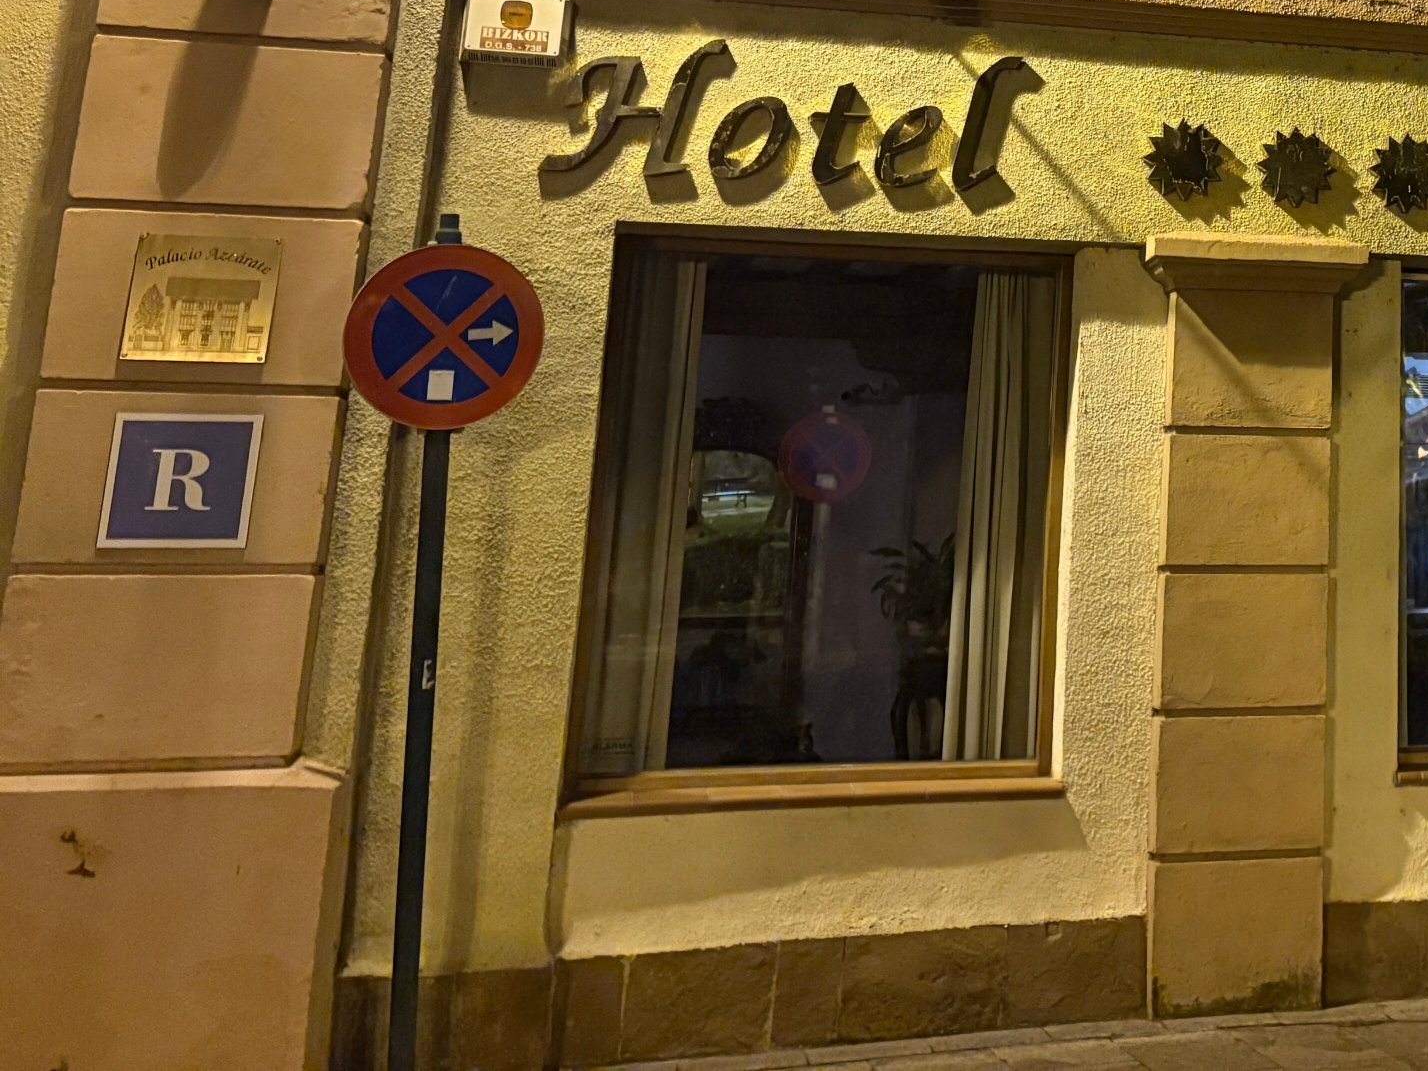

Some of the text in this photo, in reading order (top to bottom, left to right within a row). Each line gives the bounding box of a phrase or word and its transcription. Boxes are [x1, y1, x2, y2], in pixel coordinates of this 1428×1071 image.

[481, 27, 548, 42] BIZKOR
[525, 44, 542, 52] 738
[538, 39, 1024, 191] Hotel
[145, 247, 272, 275] Palacio Azcárate
[144, 448, 211, 511] R
